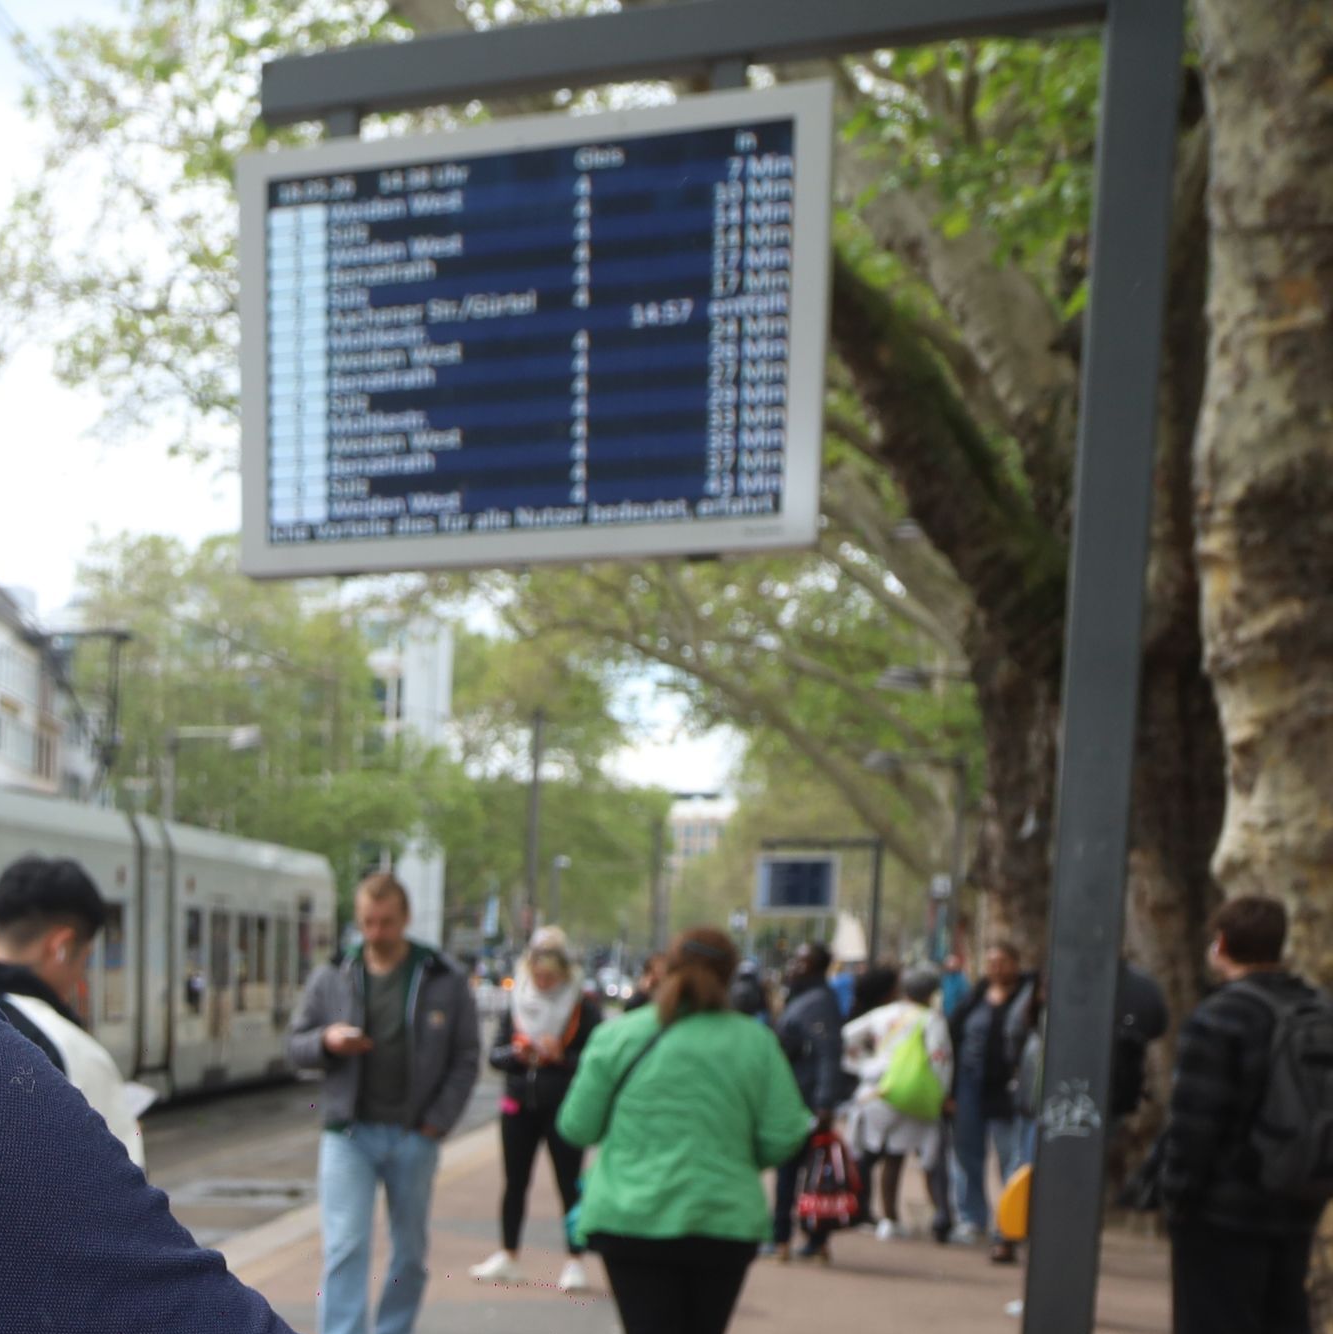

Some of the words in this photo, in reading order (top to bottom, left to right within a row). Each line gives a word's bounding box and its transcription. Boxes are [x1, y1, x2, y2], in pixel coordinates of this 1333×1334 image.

[574, 145, 625, 170] Gleis
[734, 129, 757, 152] in
[411, 188, 464, 214] West
[746, 151, 793, 178] Min
[745, 174, 792, 201] Min
[411, 233, 463, 258] West
[745, 197, 791, 224] Min
[744, 220, 790, 247] Min
[743, 243, 790, 269] Min
[743, 266, 789, 292] Min
[410, 342, 462, 366] West
[741, 312, 787, 337] Min
[740, 334, 786, 360] Min
[740, 357, 786, 382] Min
[739, 379, 785, 404] Min
[410, 428, 462, 451] West
[738, 402, 784, 426] Min
[738, 424, 783, 448] Min
[737, 446, 782, 470] Min
[410, 492, 461, 514] West
[736, 469, 782, 492] Min
[472, 507, 512, 530] alle
